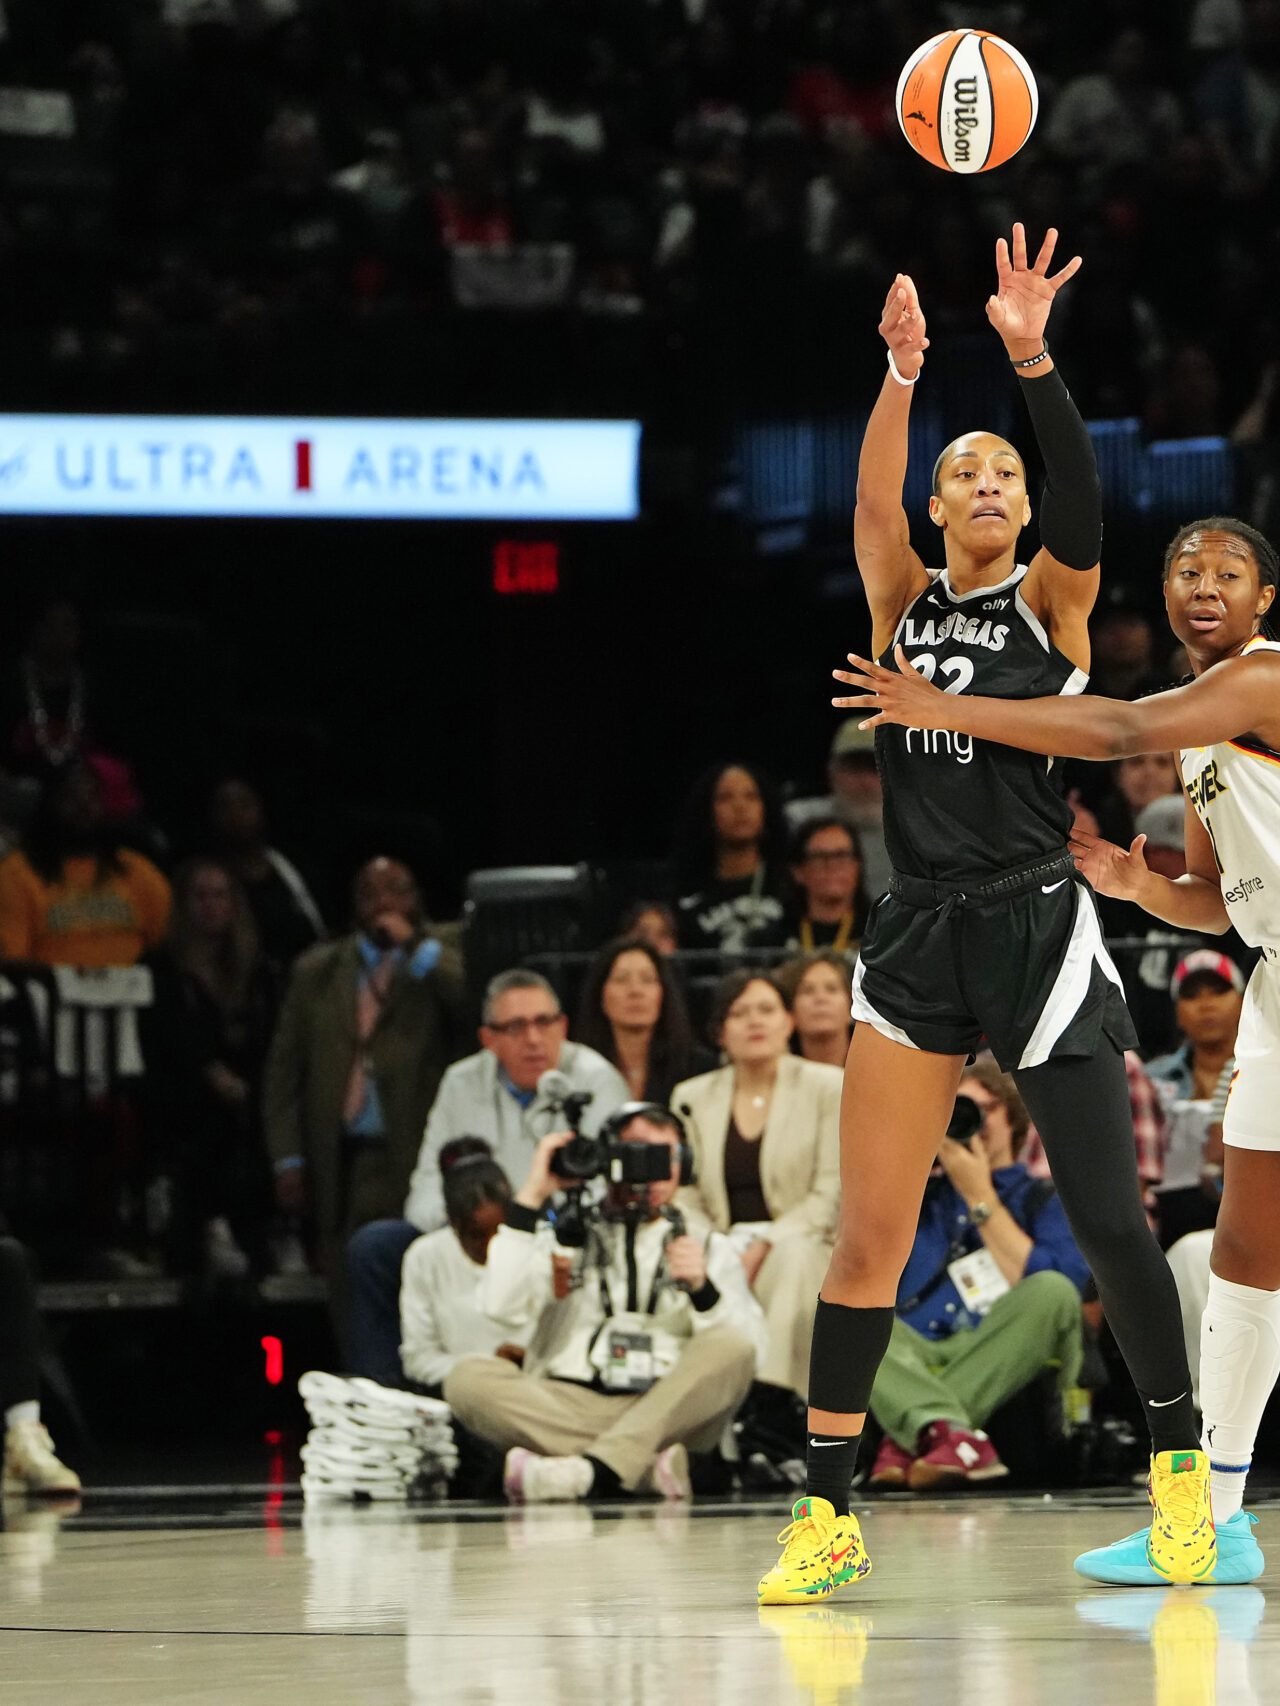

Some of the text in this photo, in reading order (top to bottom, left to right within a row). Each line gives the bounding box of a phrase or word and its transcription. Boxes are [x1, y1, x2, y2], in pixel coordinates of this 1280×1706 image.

[954, 75, 978, 162] Wilson
[54, 442, 547, 495] ULTRA ARENA
[982, 598, 1010, 611] ally
[904, 611, 1010, 651] LAS VEGAS
[905, 726, 974, 764] ring
